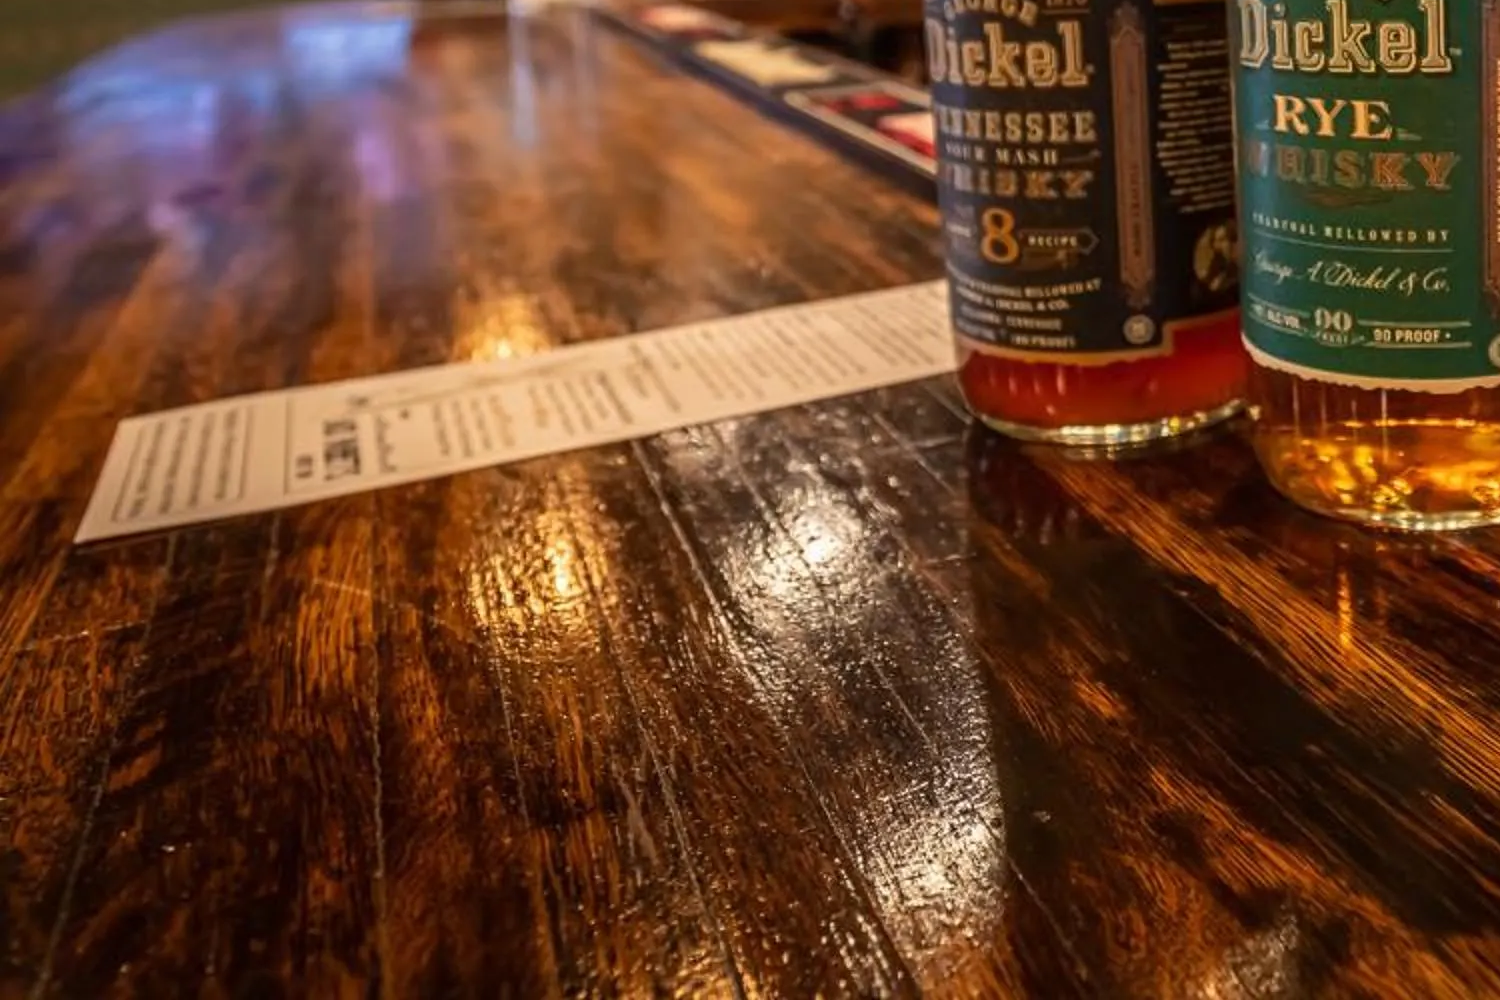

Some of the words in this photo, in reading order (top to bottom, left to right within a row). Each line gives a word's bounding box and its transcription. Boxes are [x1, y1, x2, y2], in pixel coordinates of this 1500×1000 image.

[925, 20, 1089, 87] Dickel
[1273, 94, 1394, 141] RYE
[996, 148, 1059, 165] MASH
[981, 207, 1019, 263] 8
[1373, 328, 1391, 342] 90
[1395, 329, 1440, 343] PROOF
